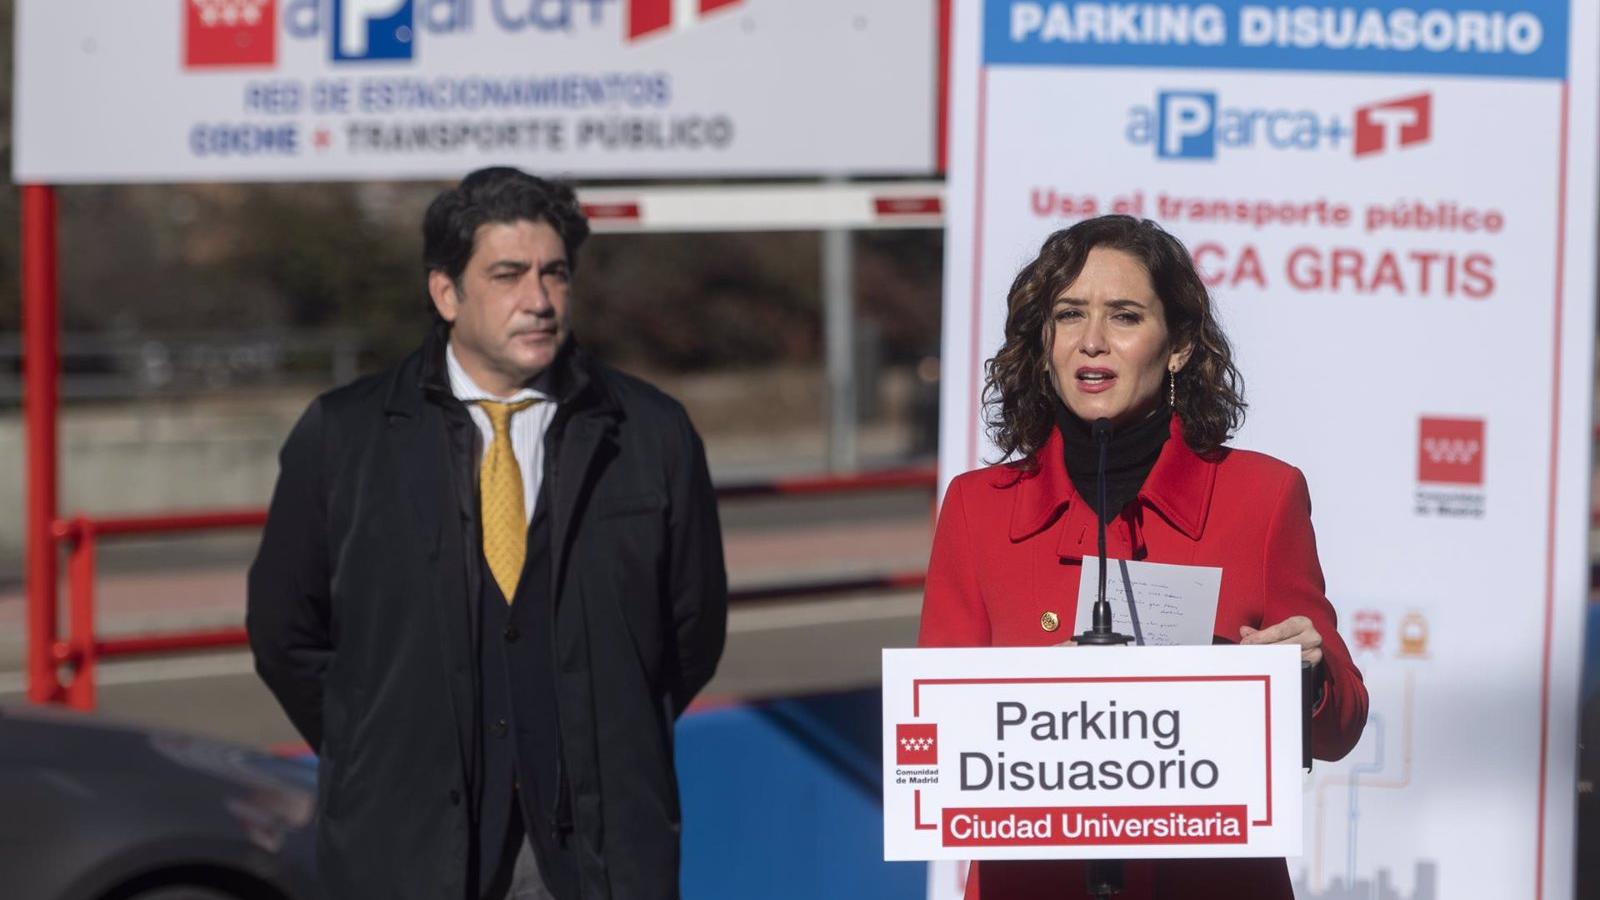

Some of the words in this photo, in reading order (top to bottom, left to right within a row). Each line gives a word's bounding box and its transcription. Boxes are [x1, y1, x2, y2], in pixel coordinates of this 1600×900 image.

[1010, 1, 1226, 46] PARKING
[1239, 6, 1543, 54] DISUASORIO
[245, 81, 300, 112] RED
[311, 80, 348, 111] DE
[359, 73, 670, 110] ESTACIONAMIENTOS
[190, 123, 299, 155] COCHE
[346, 120, 564, 151] TRANSPORTE
[1031, 187, 1097, 217] Usa
[1111, 192, 1144, 218] el
[1159, 194, 1351, 227] transporte
[1365, 199, 1505, 234] público
[1285, 245, 1497, 301] GRATIS
[996, 701, 1181, 750] Parking
[959, 750, 1219, 791] Disuasorio
[950, 813, 1052, 841] Ciudad
[1061, 812, 1241, 838] Universitaria
